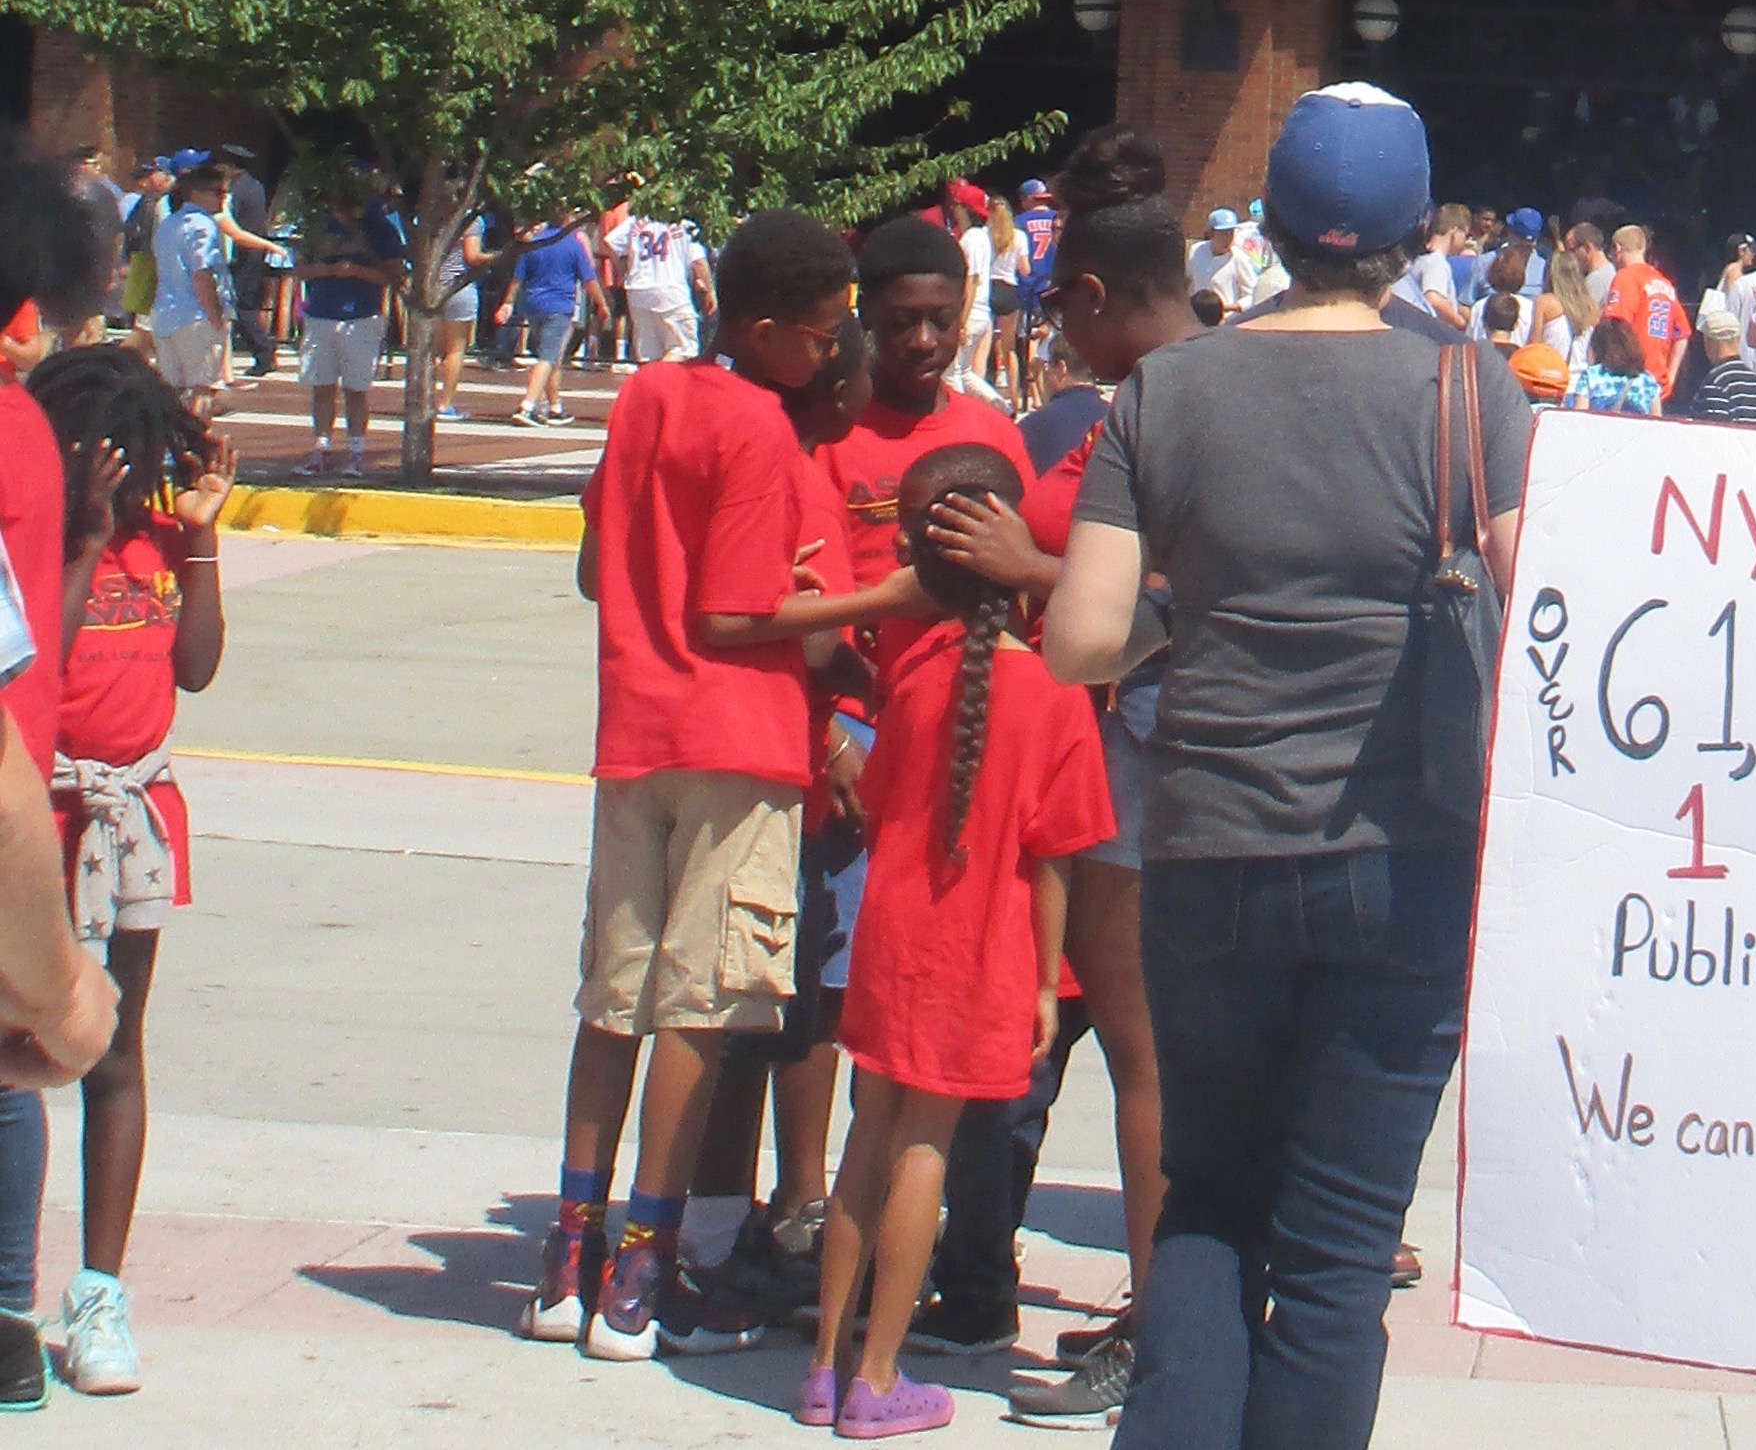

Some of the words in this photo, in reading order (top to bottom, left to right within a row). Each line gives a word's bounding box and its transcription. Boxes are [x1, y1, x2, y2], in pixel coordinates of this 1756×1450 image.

[638, 230, 670, 262] 34
[1033, 232, 1053, 260] 7
[1526, 586, 1576, 778] OVER
[1667, 782, 1729, 880] 1
[1556, 1033, 1655, 1146] We
[1675, 1111, 1755, 1158] can
